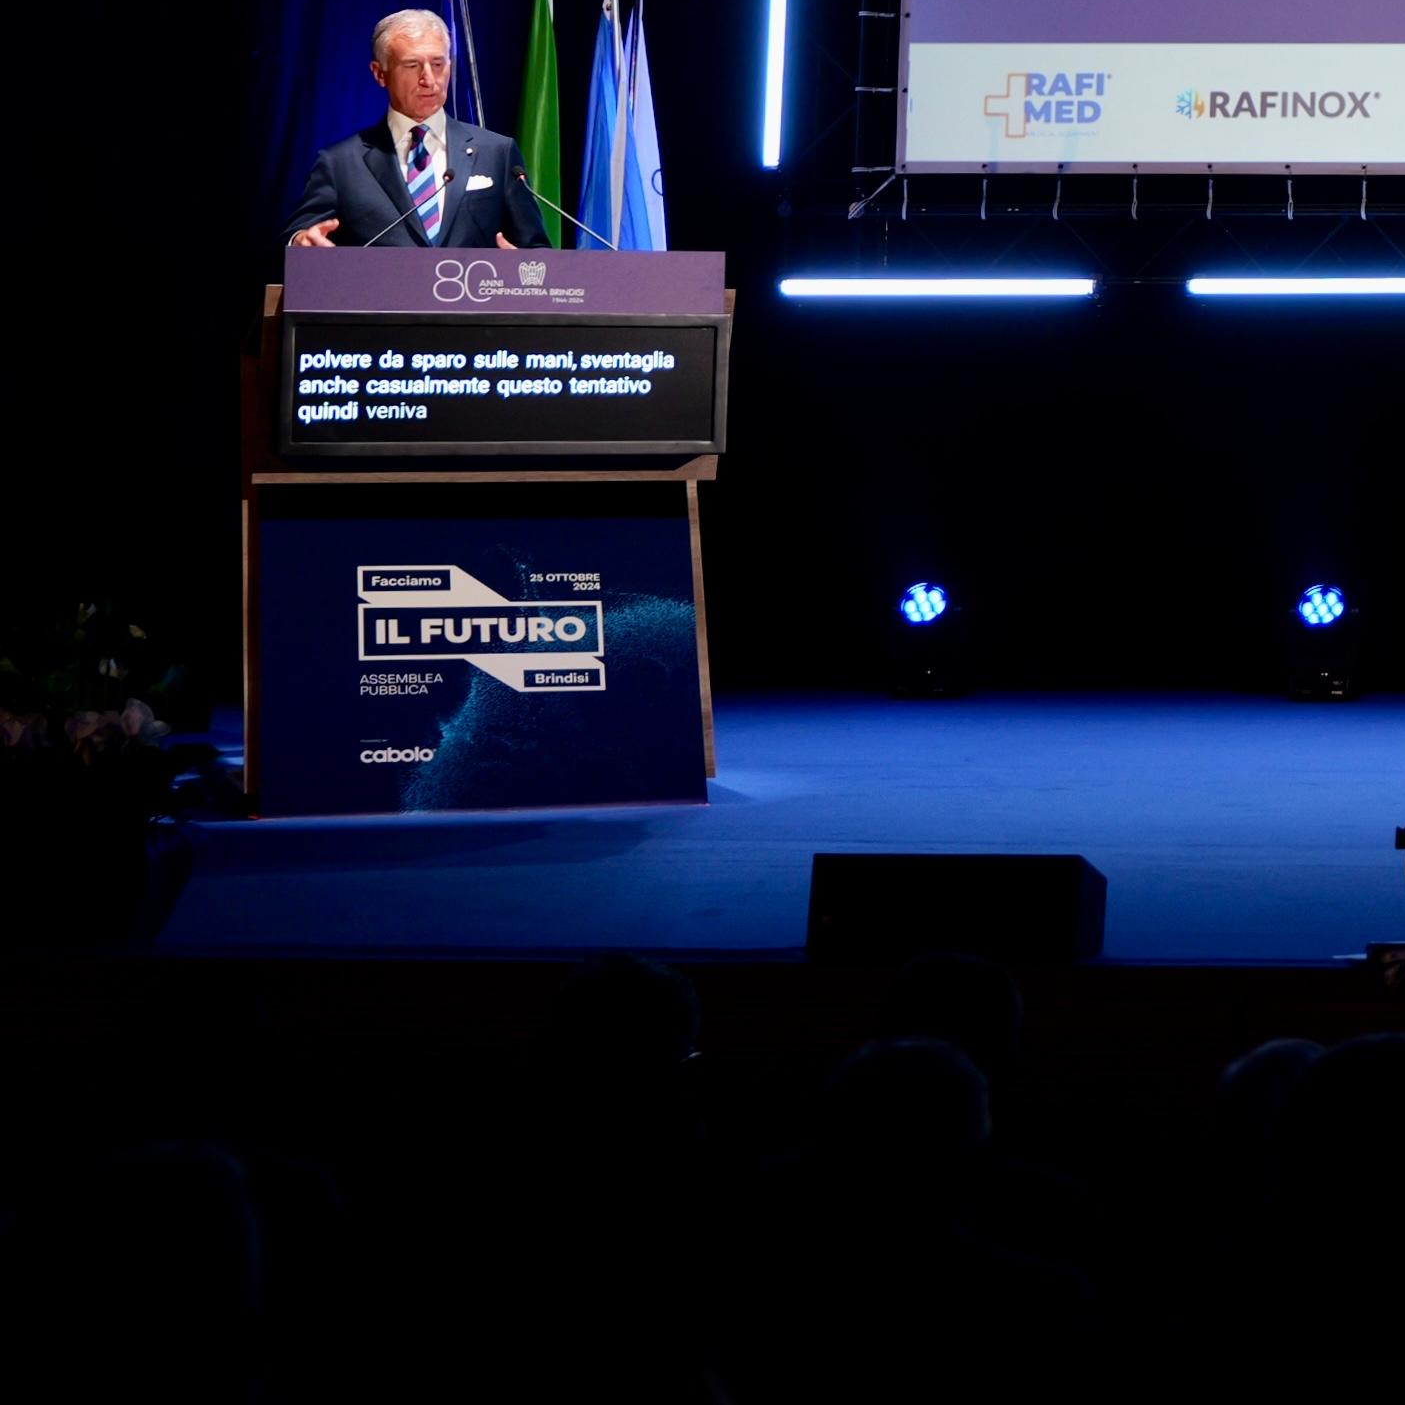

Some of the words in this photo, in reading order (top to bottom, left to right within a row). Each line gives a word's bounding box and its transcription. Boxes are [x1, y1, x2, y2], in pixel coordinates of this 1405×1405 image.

[1025, 73, 1105, 96] RAFI
[1024, 100, 1101, 124] MED
[1208, 91, 1371, 119] RAFINOX
[479, 279, 504, 287] ANNI
[478, 287, 548, 296] CONFINDUSTRIA
[549, 288, 585, 297] BRINDISI
[300, 350, 372, 373] polvere
[378, 349, 404, 369] da
[411, 351, 467, 373] sparo
[473, 349, 519, 369] sulle
[525, 350, 578, 371] mani,
[580, 350, 675, 373] sventaglia
[299, 375, 360, 395] anche
[365, 375, 490, 395] casualmente
[497, 376, 563, 398] questo
[569, 376, 652, 395] tentativo
[298, 401, 359, 425] quindi
[365, 401, 428, 421] veniva
[371, 575, 442, 587] Facciamo
[529, 573, 544, 583] 25
[548, 572, 601, 583] OTTOBRE
[572, 582, 601, 591] 2024
[375, 618, 411, 645] IL
[420, 616, 587, 644] FUTURO
[360, 673, 443, 685] ASSEMBLEA
[534, 673, 589, 685] Brindisi
[360, 684, 429, 696] PUBBLICA
[360, 746, 434, 764] cabolo
